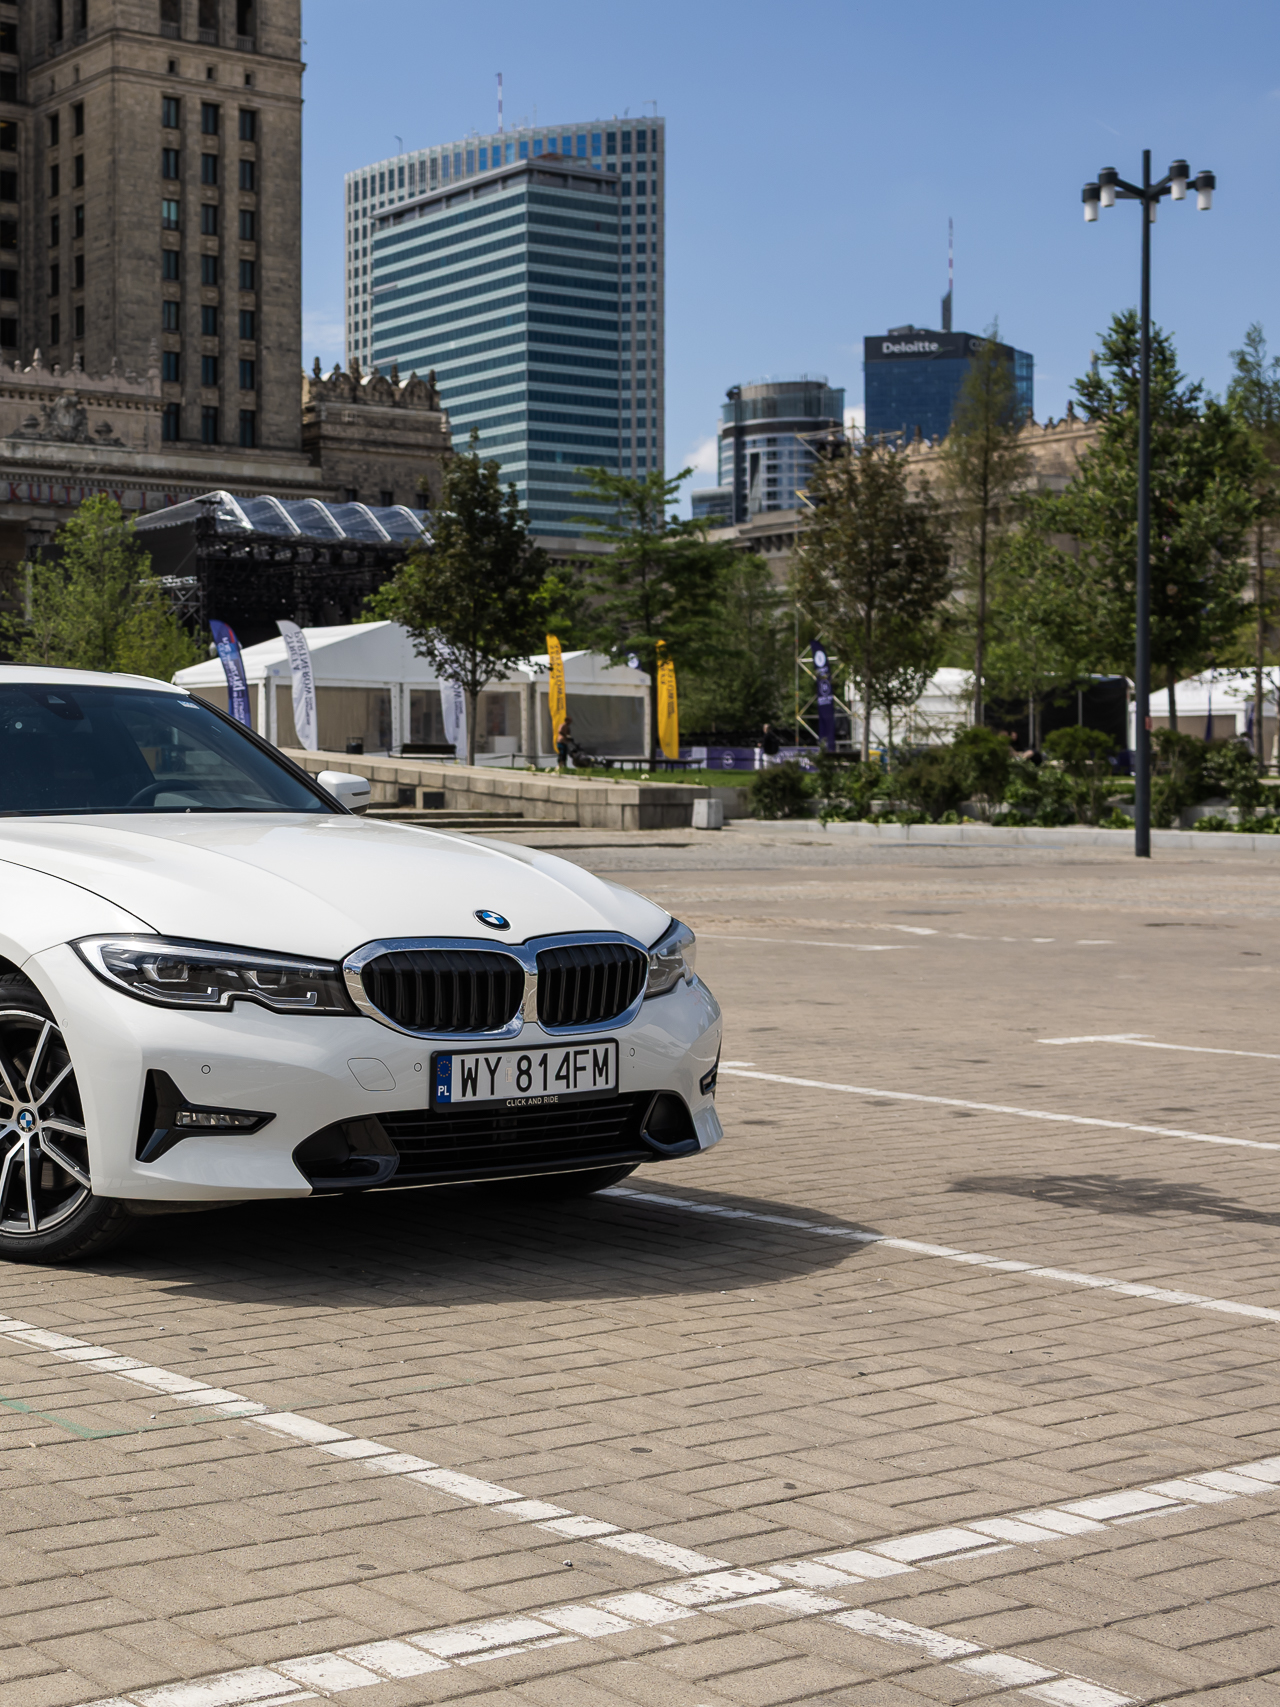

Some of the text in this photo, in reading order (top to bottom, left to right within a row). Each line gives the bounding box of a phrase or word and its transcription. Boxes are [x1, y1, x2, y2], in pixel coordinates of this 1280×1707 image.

[460, 1047, 610, 1098] WY 814FM
[437, 1085, 450, 1097] PL
[506, 1096, 559, 1107] CLICK AND RIDE
